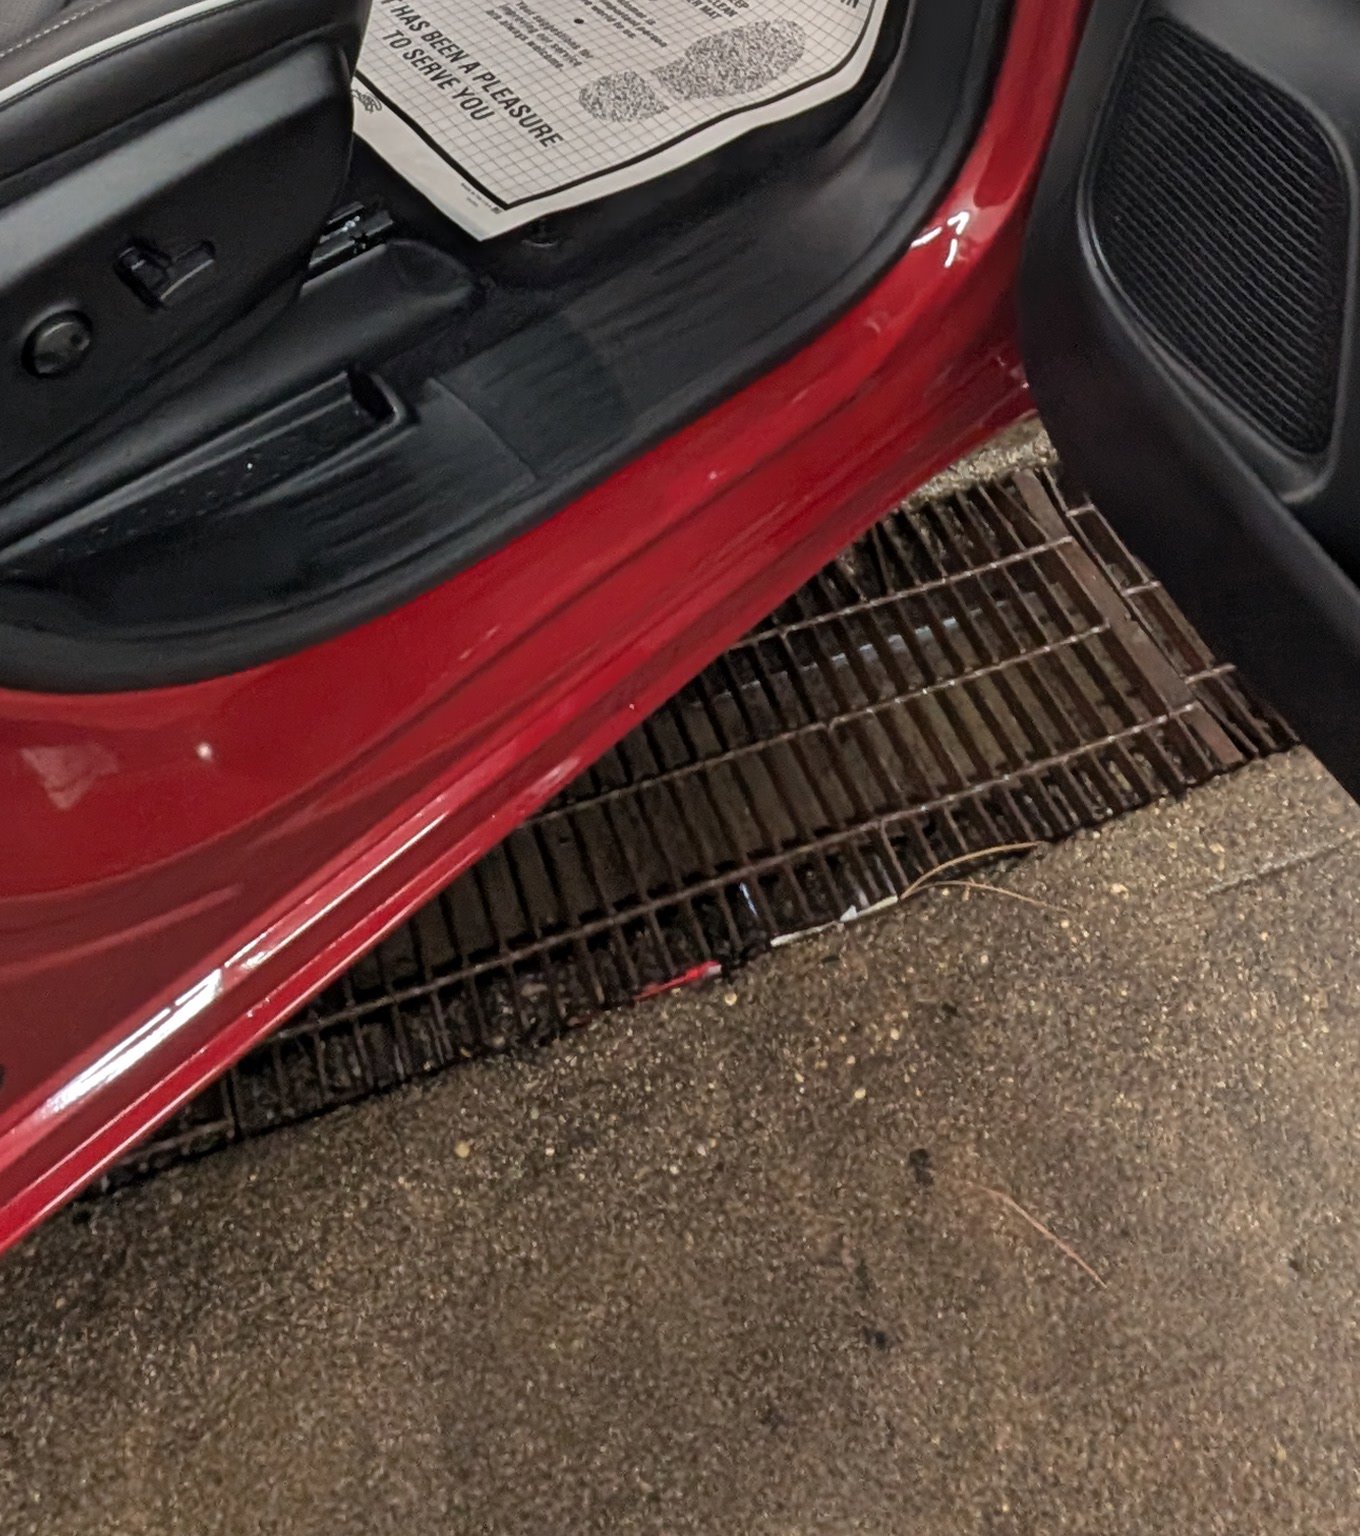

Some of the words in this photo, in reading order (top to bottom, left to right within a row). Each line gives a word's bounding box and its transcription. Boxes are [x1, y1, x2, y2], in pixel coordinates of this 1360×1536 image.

[700, 5, 722, 20] MAT
[383, 29, 411, 49] TO
[403, 48, 460, 89] SERVE
[452, 87, 495, 120] YOU
[391, 5, 430, 32] HAS
[421, 30, 469, 64] BEEN
[458, 61, 481, 74] A
[472, 71, 564, 147] PLEASURE
